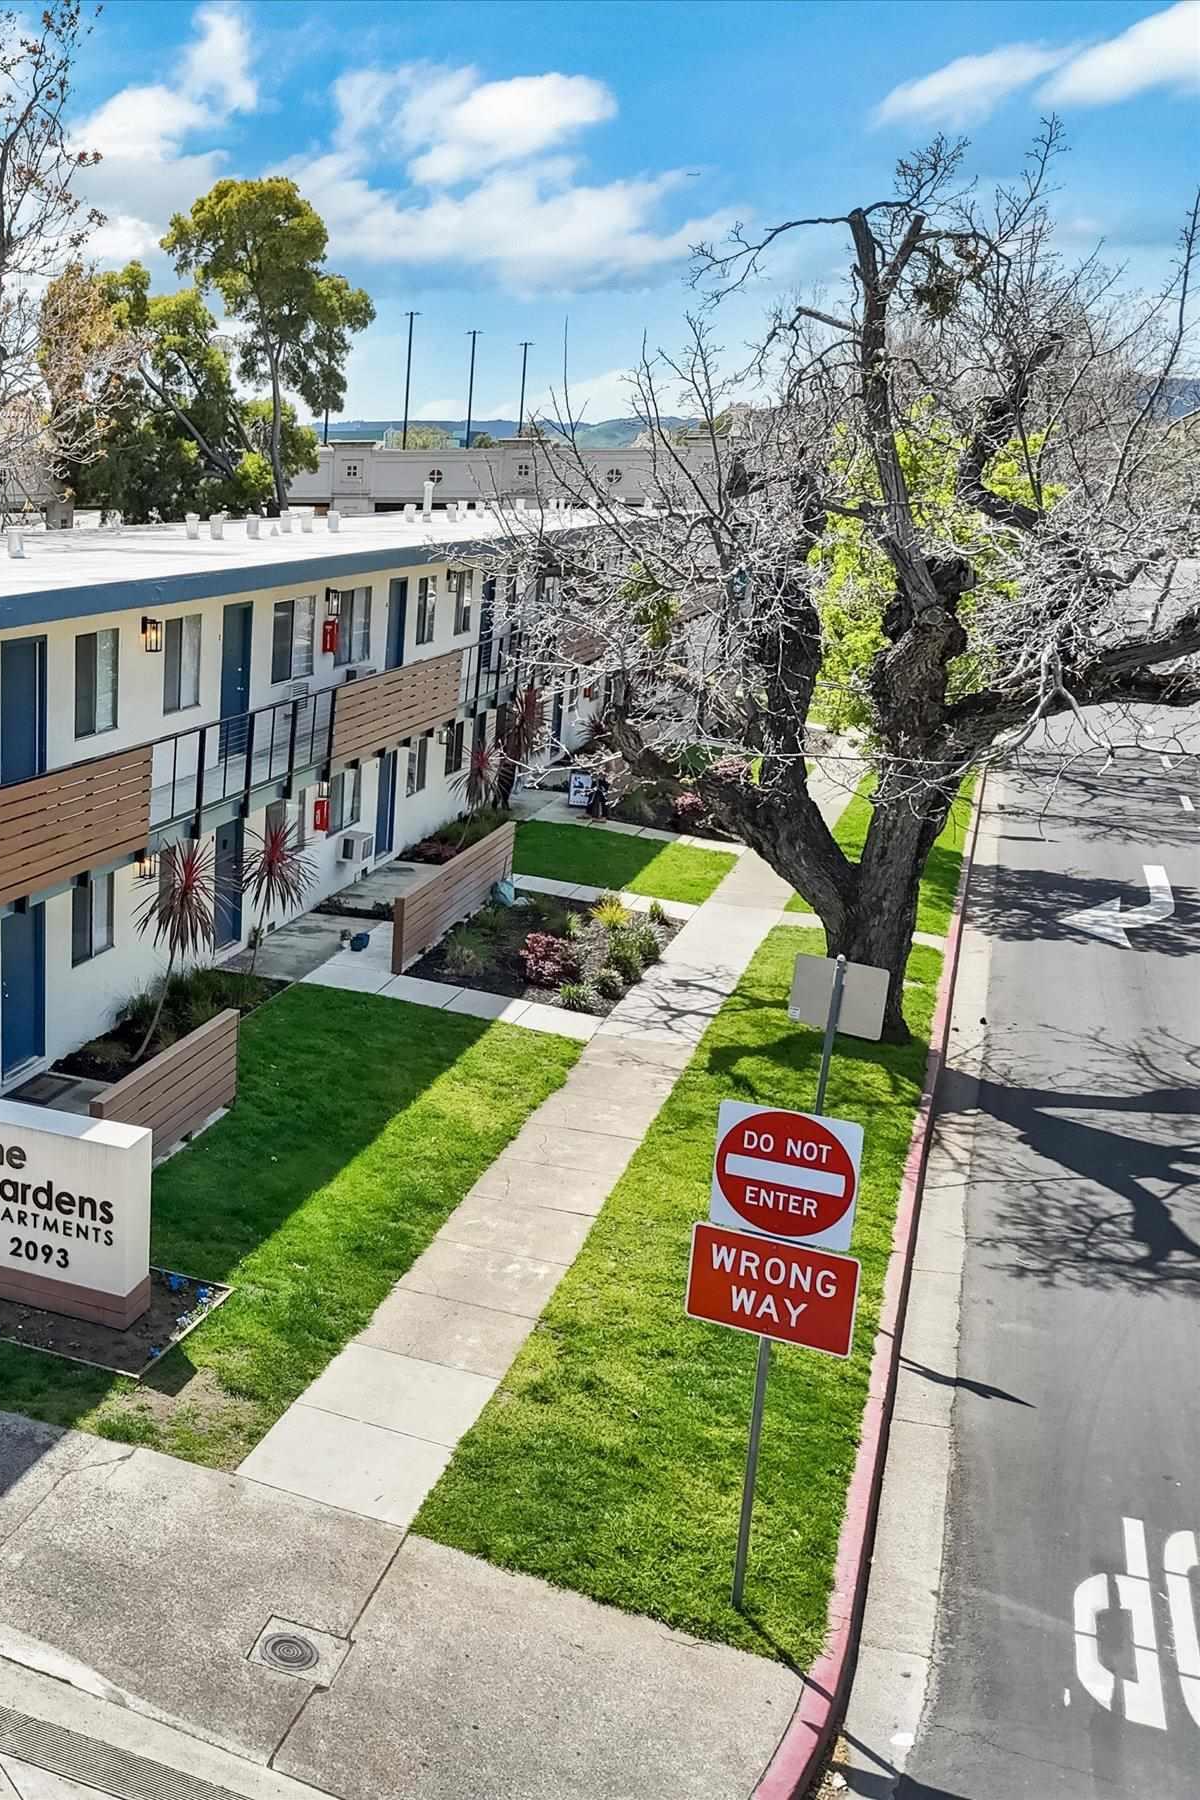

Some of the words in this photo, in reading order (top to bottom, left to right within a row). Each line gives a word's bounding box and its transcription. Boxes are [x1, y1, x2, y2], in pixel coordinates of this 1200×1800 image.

[743, 1130, 775, 1152] DO
[785, 1138, 833, 1164] NOT
[745, 1186, 818, 1218] ENTER
[9, 1236, 70, 1269] 2093
[711, 1243, 838, 1299] WRONG
[731, 1285, 808, 1328] WAY
